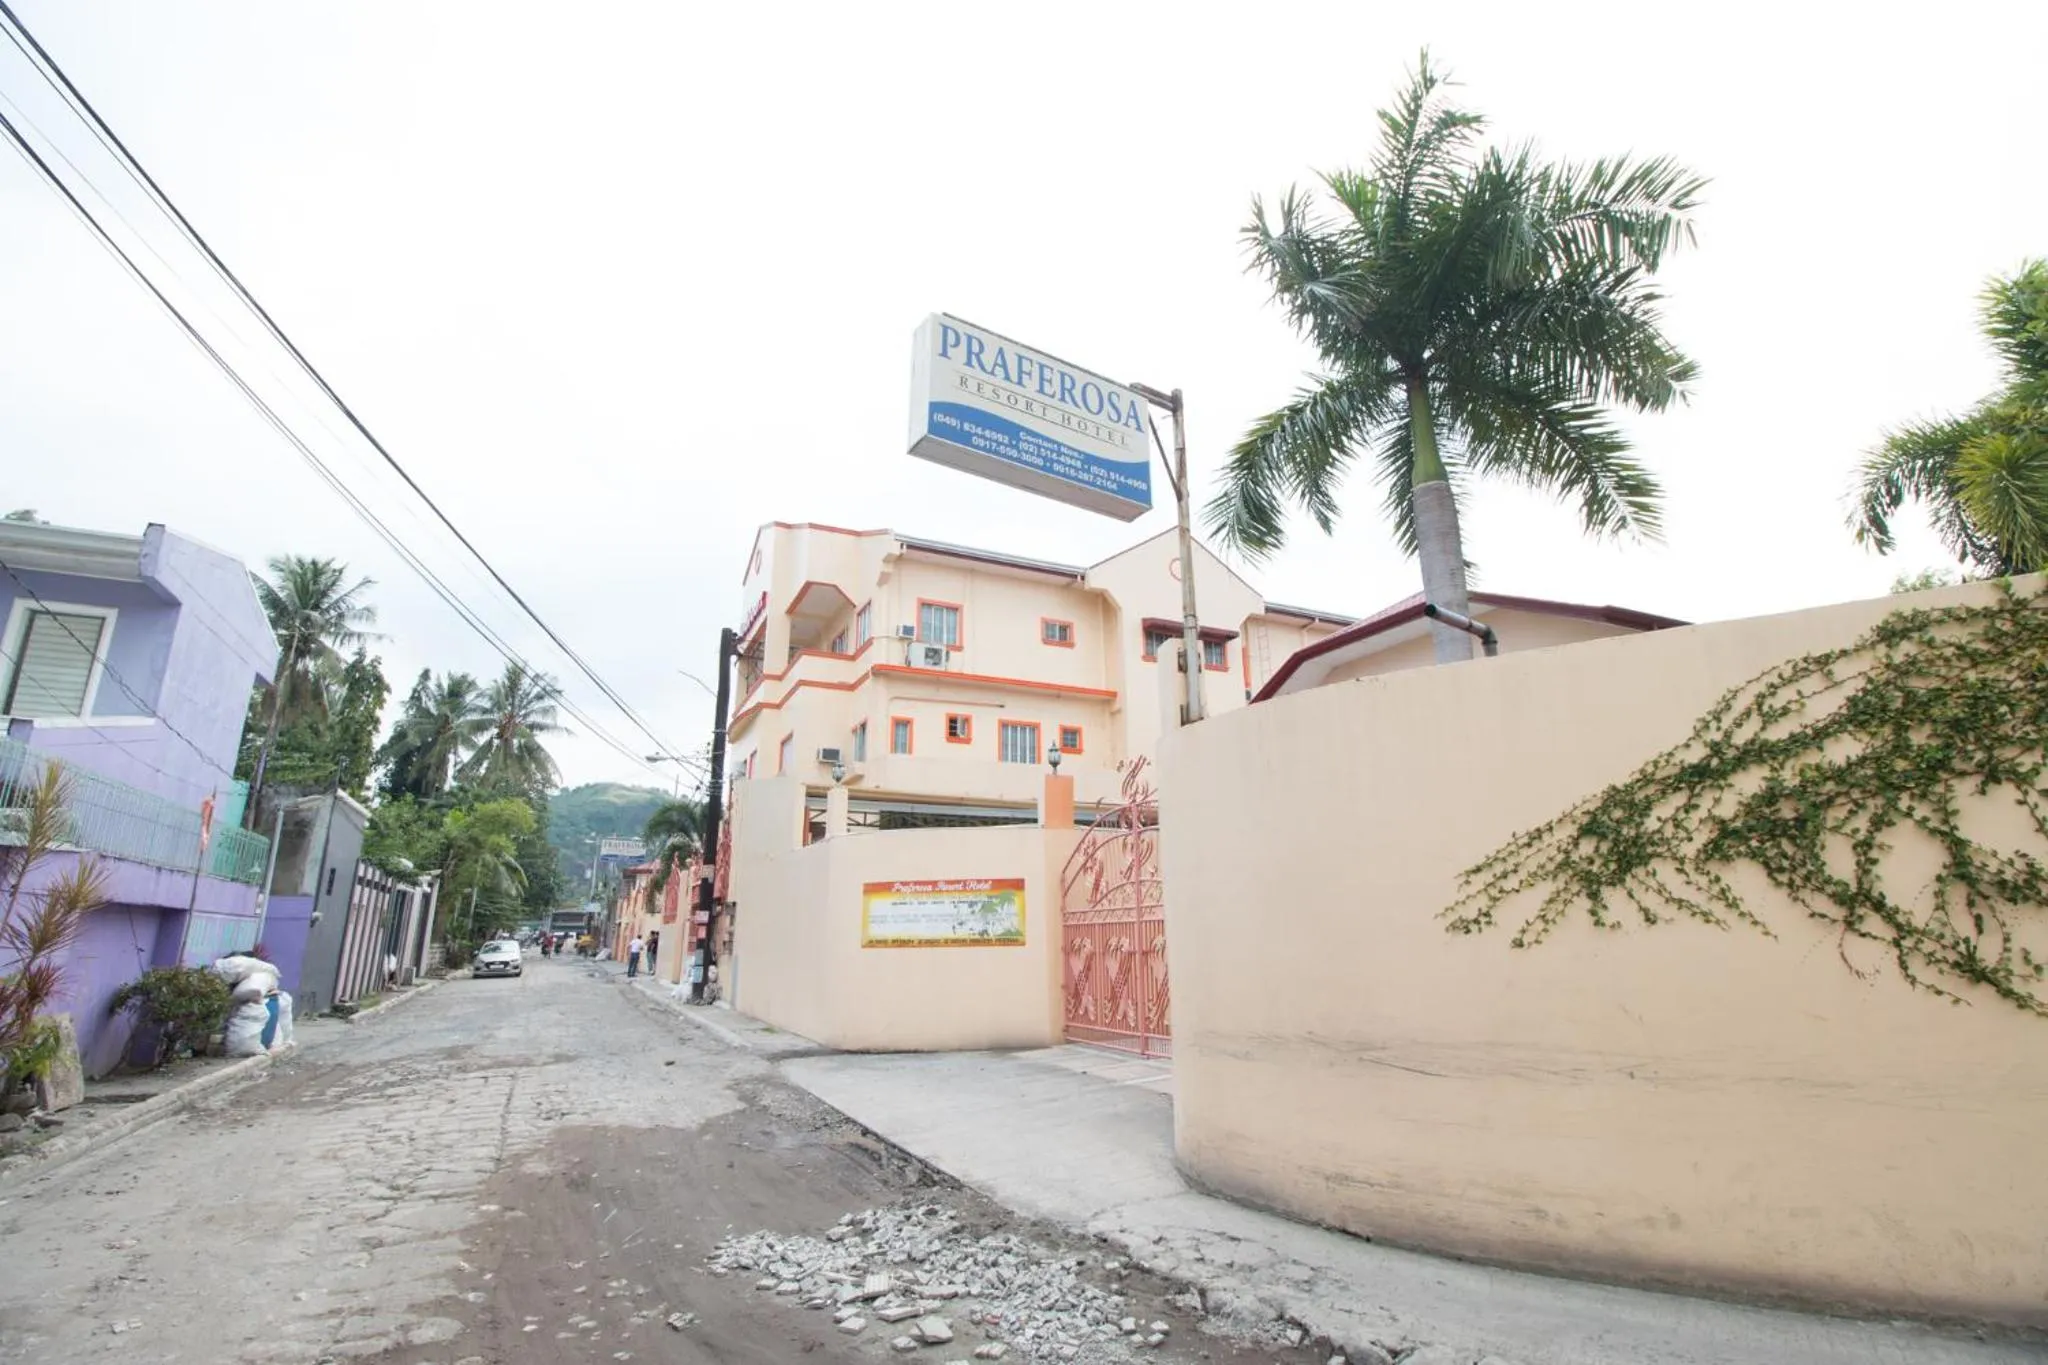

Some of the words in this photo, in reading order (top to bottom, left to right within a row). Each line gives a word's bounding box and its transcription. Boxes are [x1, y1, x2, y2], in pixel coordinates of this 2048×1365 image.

[938, 322, 1146, 434] PRAFEROSA
[959, 375, 1049, 418] RESORT
[1061, 412, 1129, 446] HOTEL
